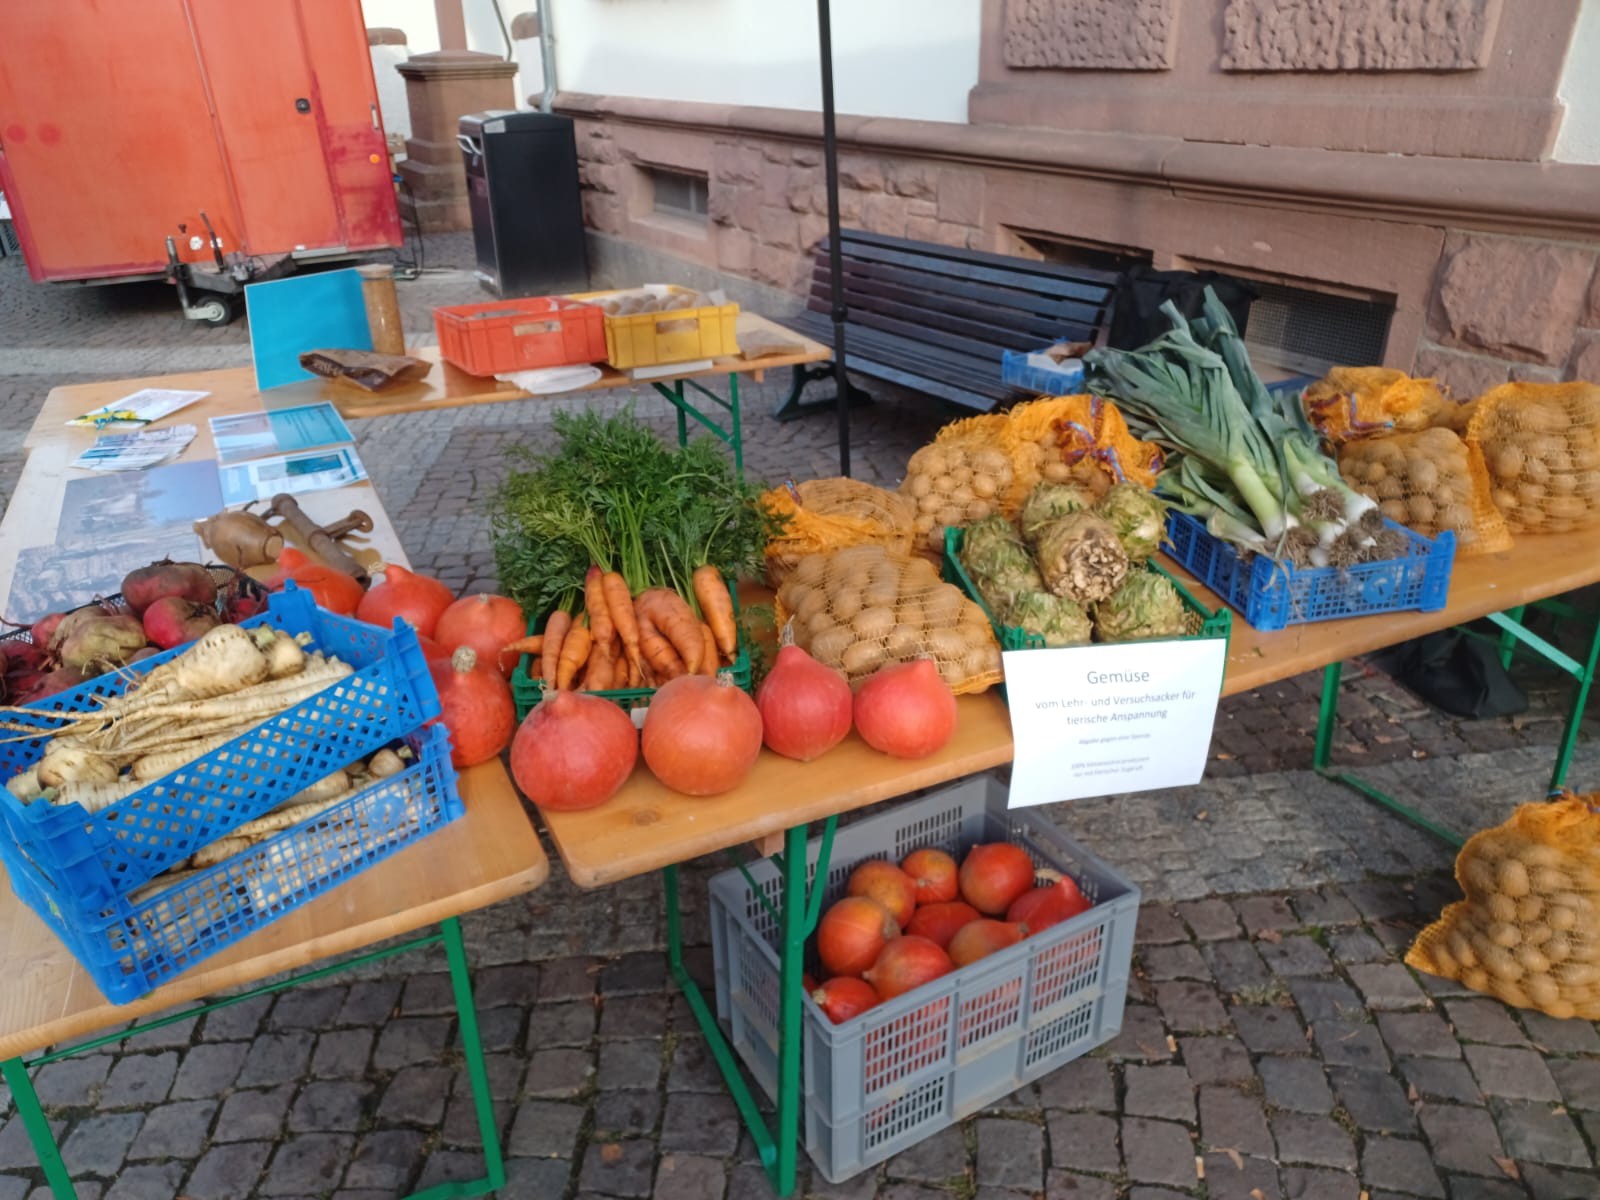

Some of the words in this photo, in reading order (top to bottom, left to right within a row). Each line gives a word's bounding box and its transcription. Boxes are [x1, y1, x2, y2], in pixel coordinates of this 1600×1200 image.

[1087, 669, 1150, 684] Gemüse
[1035, 702, 1058, 710] vom
[1062, 697, 1087, 708] Lehr-
[1091, 696, 1111, 706] und
[1113, 691, 1180, 705] Versuchsacker
[1182, 688, 1196, 700] für
[1067, 712, 1108, 725] tierische
[1110, 708, 1168, 722] Anspannung
